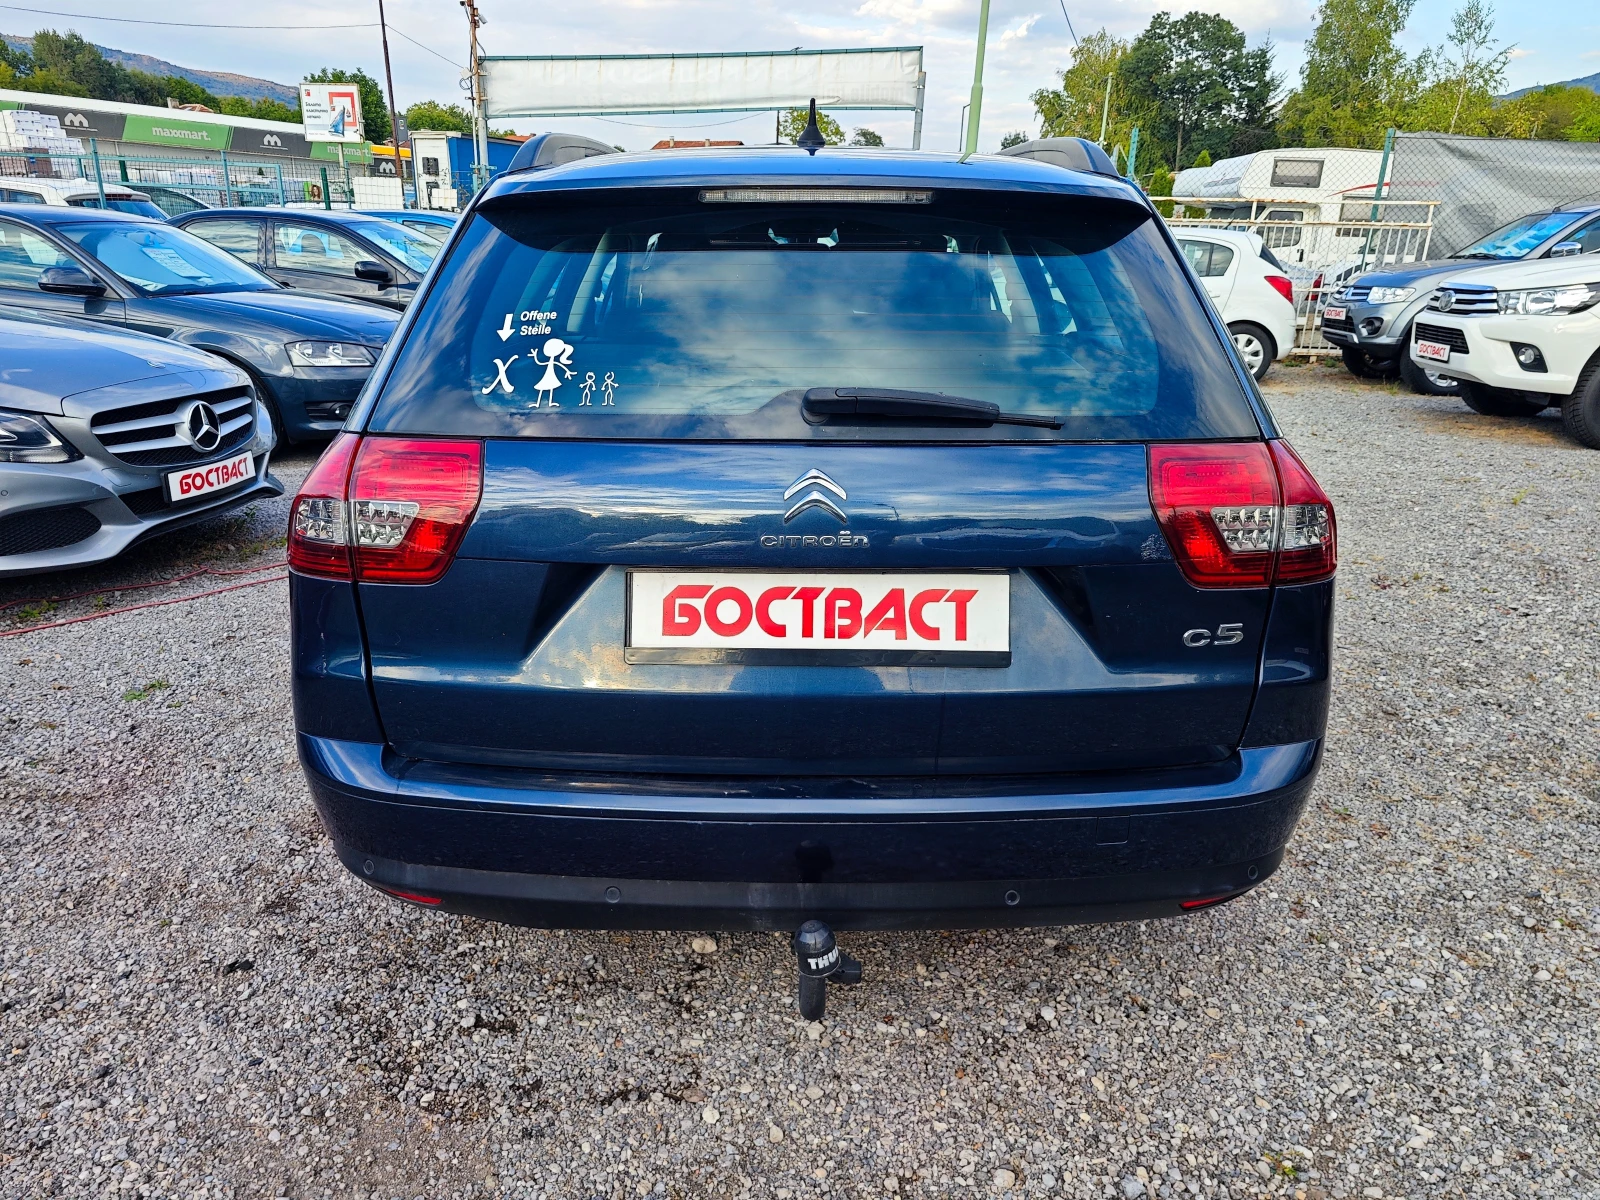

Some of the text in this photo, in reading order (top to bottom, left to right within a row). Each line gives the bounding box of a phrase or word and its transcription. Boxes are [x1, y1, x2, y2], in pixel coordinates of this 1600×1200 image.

[519, 310, 558, 321] Offene
[519, 324, 552, 336] Stelle
[179, 457, 248, 495] БОСТВАСТ
[661, 584, 979, 641] БОСТВАСТ
[1182, 623, 1244, 648] C5
